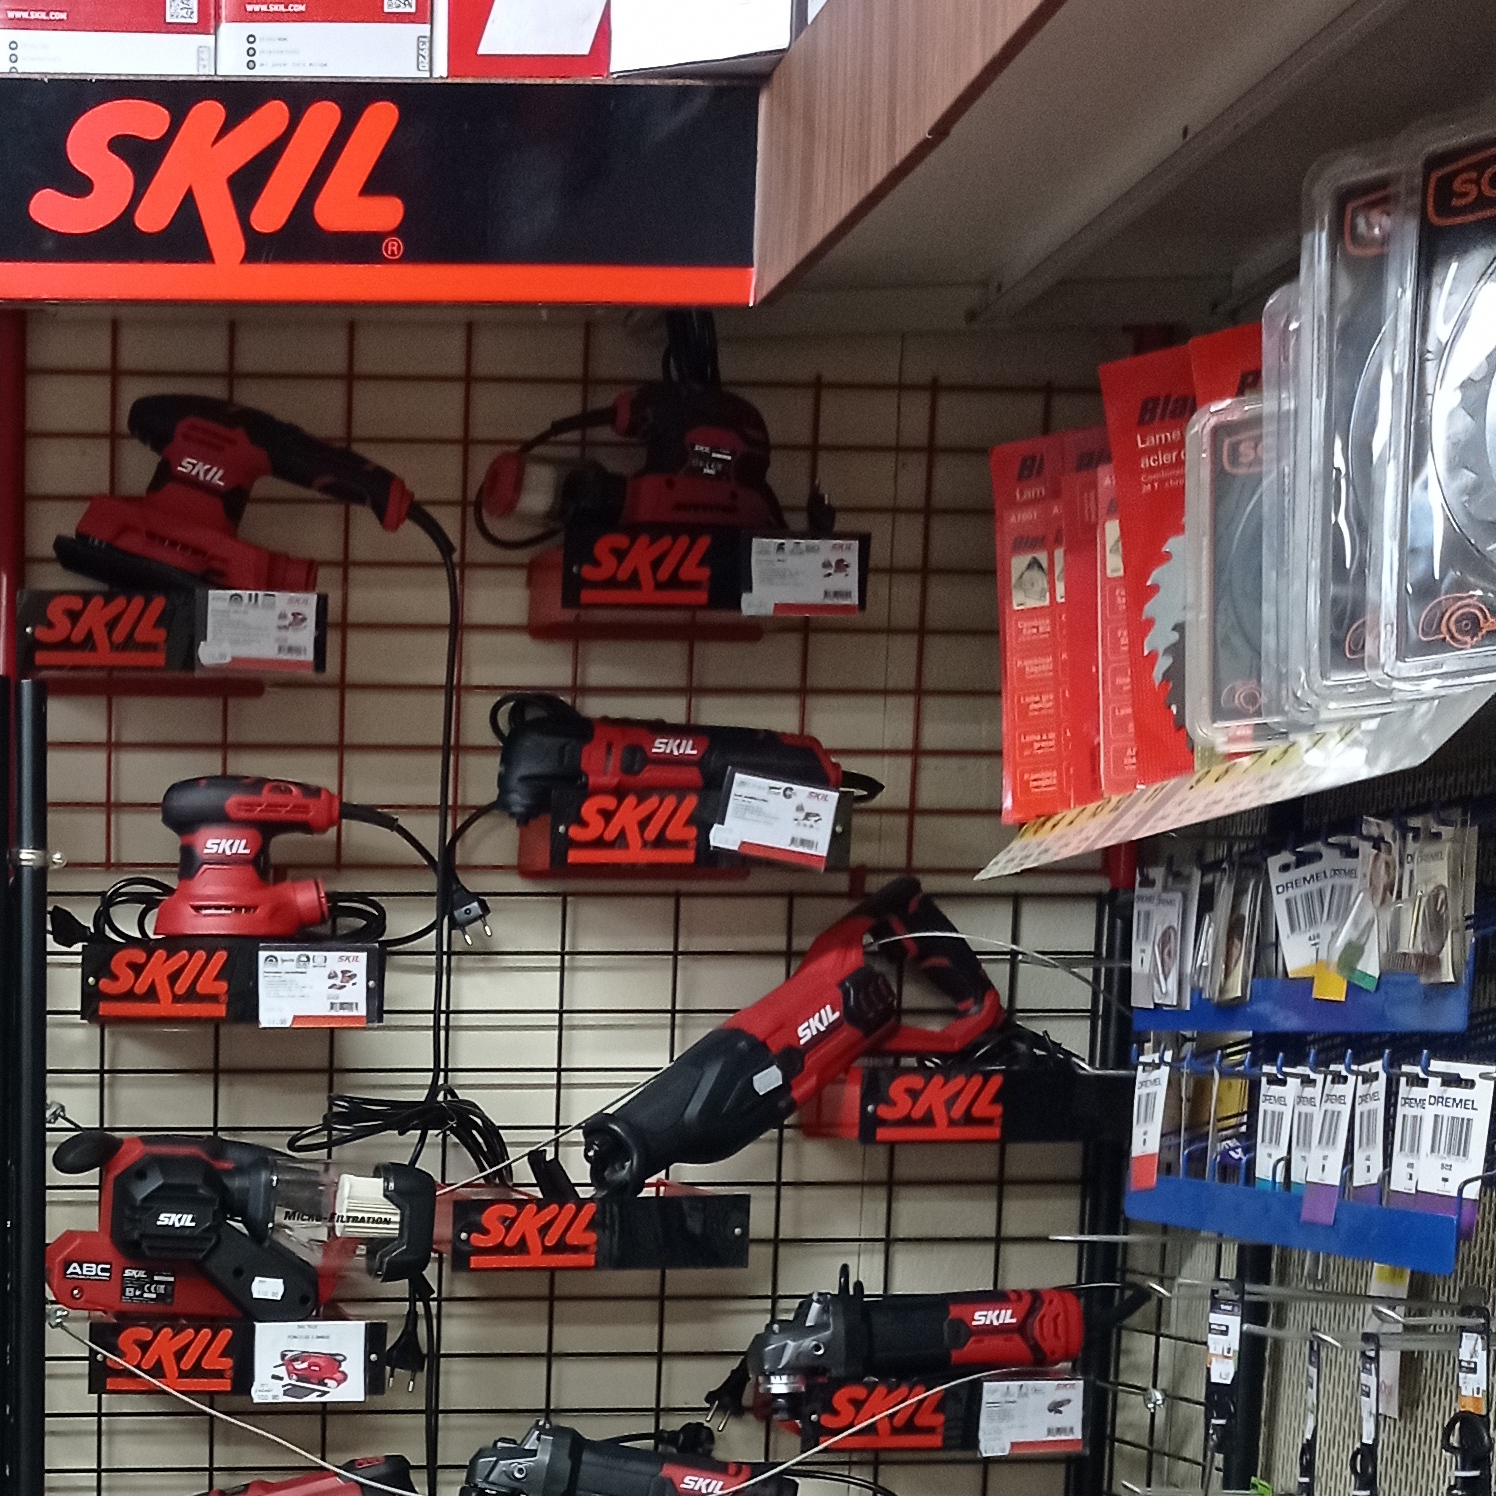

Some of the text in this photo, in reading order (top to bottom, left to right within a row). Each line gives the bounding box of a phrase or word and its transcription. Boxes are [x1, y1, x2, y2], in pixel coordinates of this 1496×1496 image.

[29, 99, 404, 265] SKIL
[1136, 427, 1181, 449] Lame
[177, 457, 225, 486] SKIL
[1140, 448, 1181, 468] acier
[580, 534, 710, 590] SKIL
[34, 595, 166, 652] SKIL
[652, 738, 697, 755] SKIL
[568, 794, 697, 850] SKIL
[203, 838, 251, 856] SKIL
[338, 955, 359, 963] SKIL
[98, 948, 228, 1004] SKIL
[797, 1004, 840, 1045] SKIL
[876, 1074, 1003, 1128] SKIL
[1428, 1094, 1479, 1111] DREMEL
[156, 1213, 196, 1227] SKIL
[470, 1203, 597, 1257] SKIL
[65, 1263, 111, 1276] ABC
[971, 1311, 1016, 1326] SKIL
[106, 1328, 233, 1384] SKIL
[820, 1384, 945, 1438] SKIL
[680, 1476, 726, 1494] SKIL
